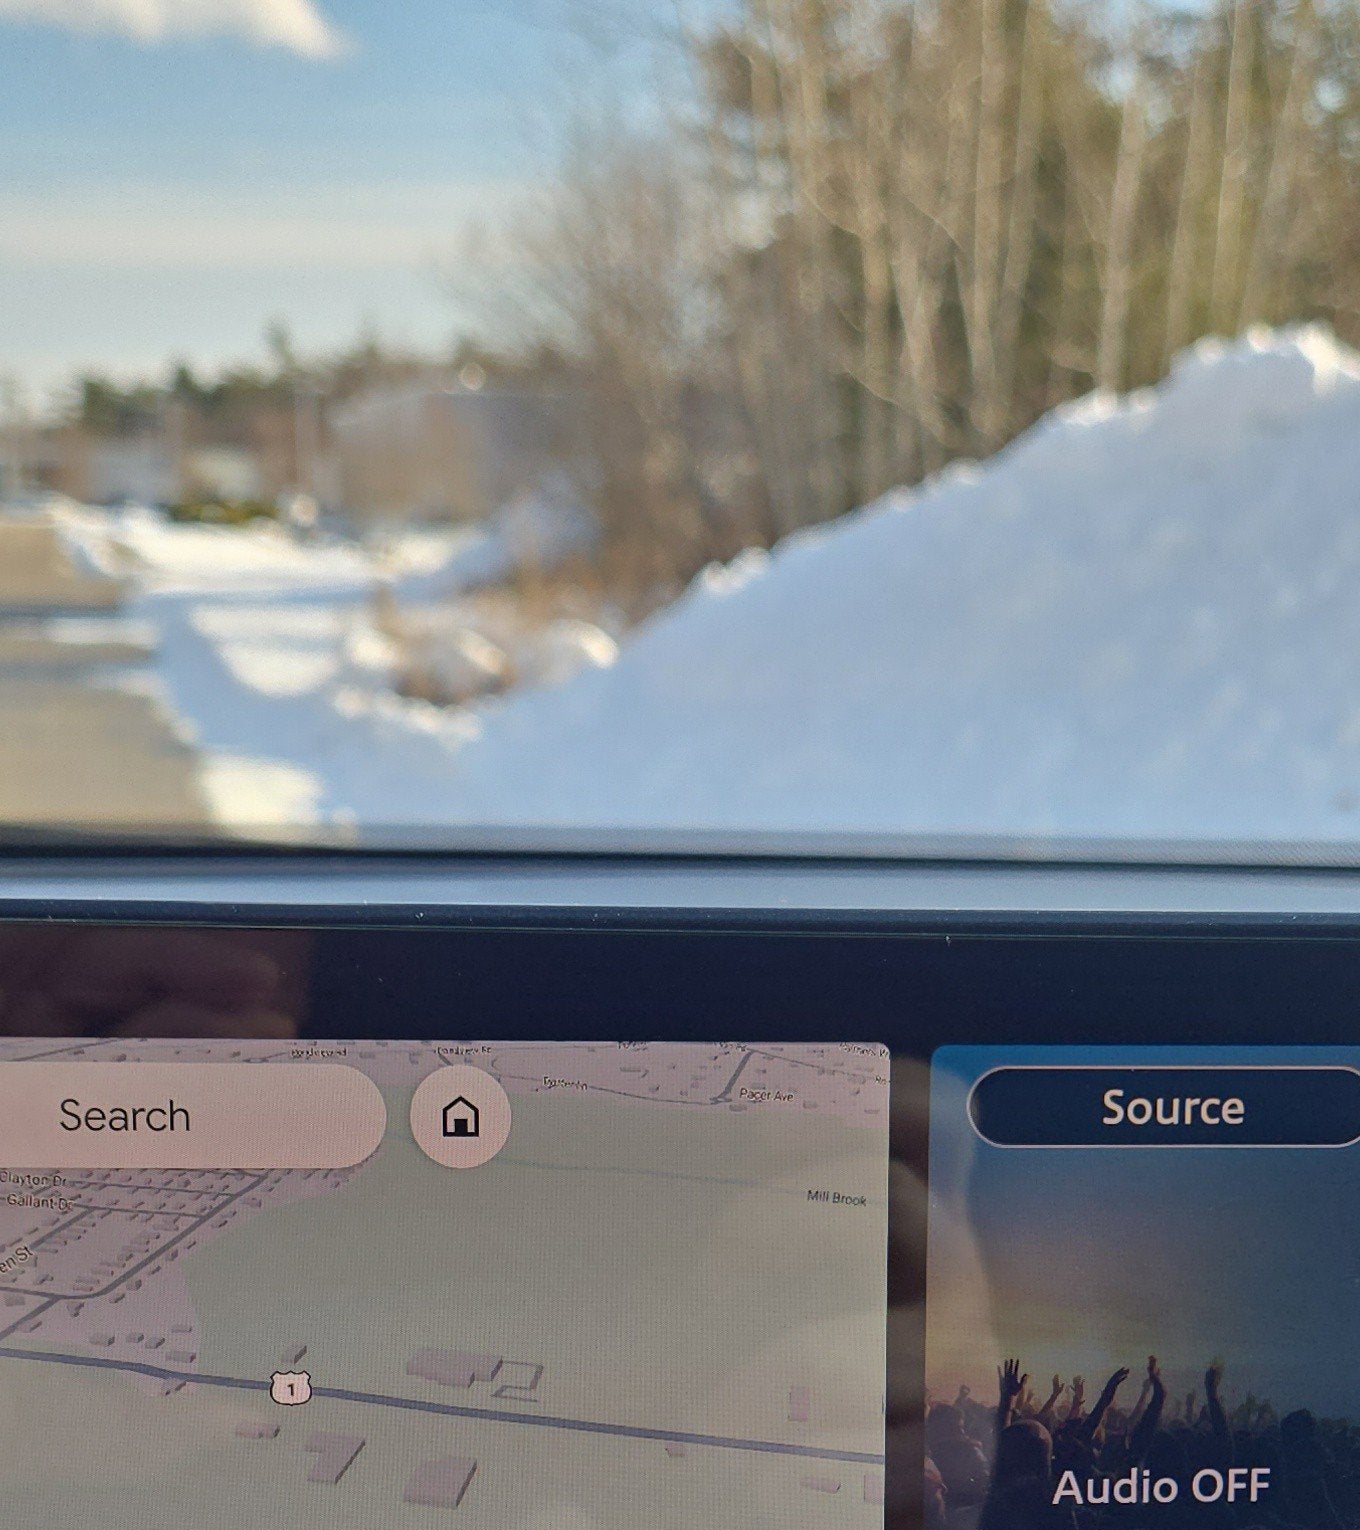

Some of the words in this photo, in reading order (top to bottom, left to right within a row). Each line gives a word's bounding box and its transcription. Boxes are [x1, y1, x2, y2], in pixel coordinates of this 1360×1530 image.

[59, 1097, 191, 1133] Search
[1101, 1089, 1246, 1126] Source
[52, 1174, 67, 1187] Dr
[6, 1193, 54, 1209] Gallant
[806, 1188, 830, 1202] Mill
[832, 1191, 868, 1207] Brook
[15, 1244, 34, 1262] St
[1051, 1465, 1180, 1506] Audio
[1191, 1466, 1272, 1505] OFF
